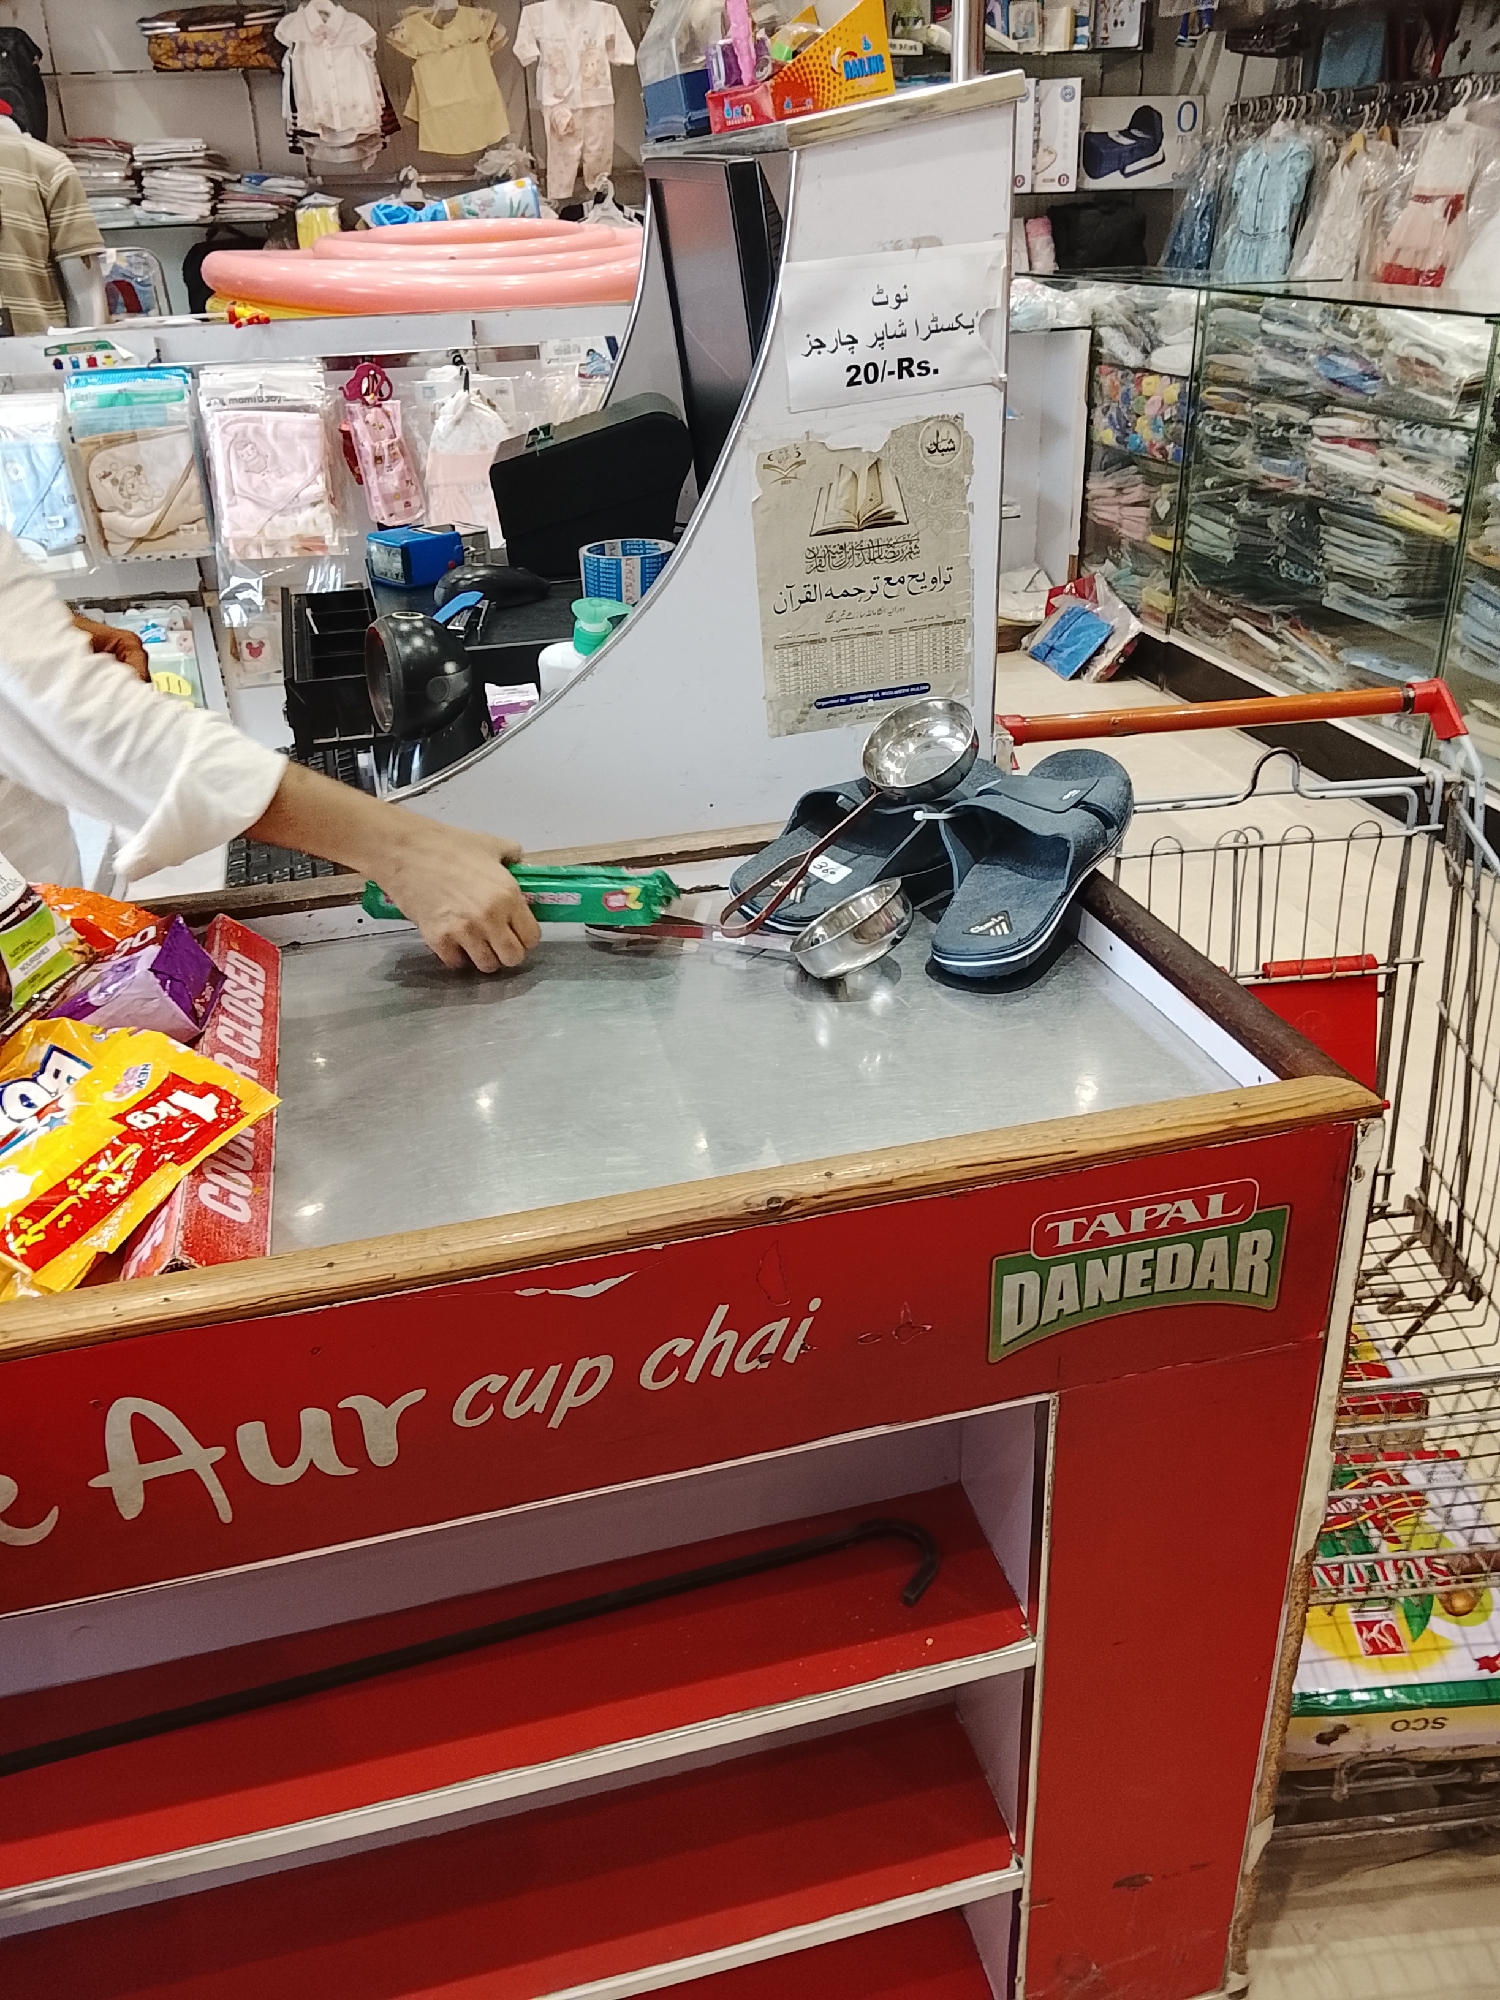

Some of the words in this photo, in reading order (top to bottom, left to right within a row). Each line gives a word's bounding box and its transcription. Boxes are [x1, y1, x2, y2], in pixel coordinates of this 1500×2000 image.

[871, 284, 909, 310] نوٹ
[801, 328, 859, 357] چارجز
[866, 318, 907, 350] شاپر
[845, 357, 940, 388] 20/-Rs.
[883, 574, 905, 598] مع
[907, 566, 954, 595] تراویح
[773, 582, 822, 614] القرآن
[216, 949, 266, 1060] CLOSED
[135, 1063, 152, 1089] NEW
[1045, 1192, 1245, 1249] TAPAL
[1000, 1228, 1274, 1346] DANEDAR
[87, 1387, 427, 1524] Aur
[450, 1352, 611, 1430] cup
[638, 1298, 822, 1391] chai
